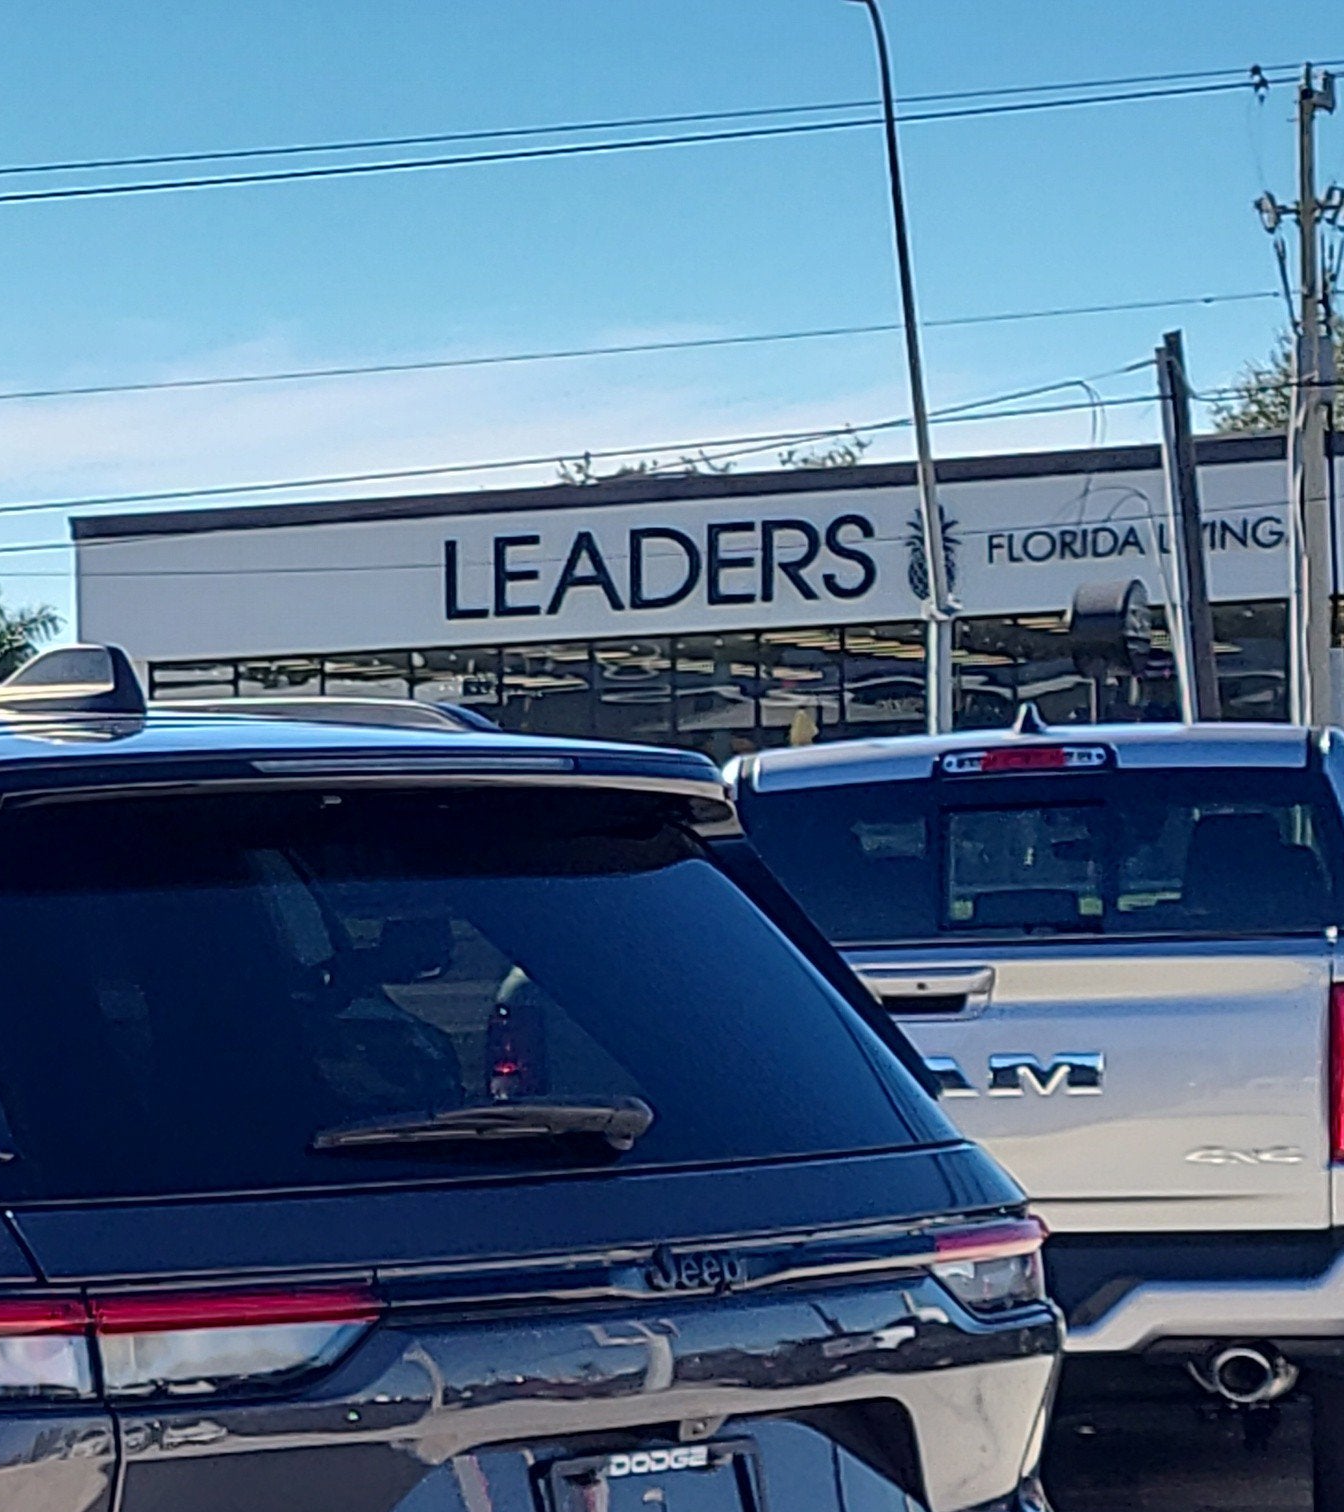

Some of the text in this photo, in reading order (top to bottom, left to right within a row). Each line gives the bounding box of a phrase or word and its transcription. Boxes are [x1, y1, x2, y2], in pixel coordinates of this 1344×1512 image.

[987, 516, 1285, 564] FLORIDA LING
[444, 513, 877, 620] LEADERS
[649, 1244, 742, 1296] Jeep
[609, 1445, 709, 1478] DODGE
